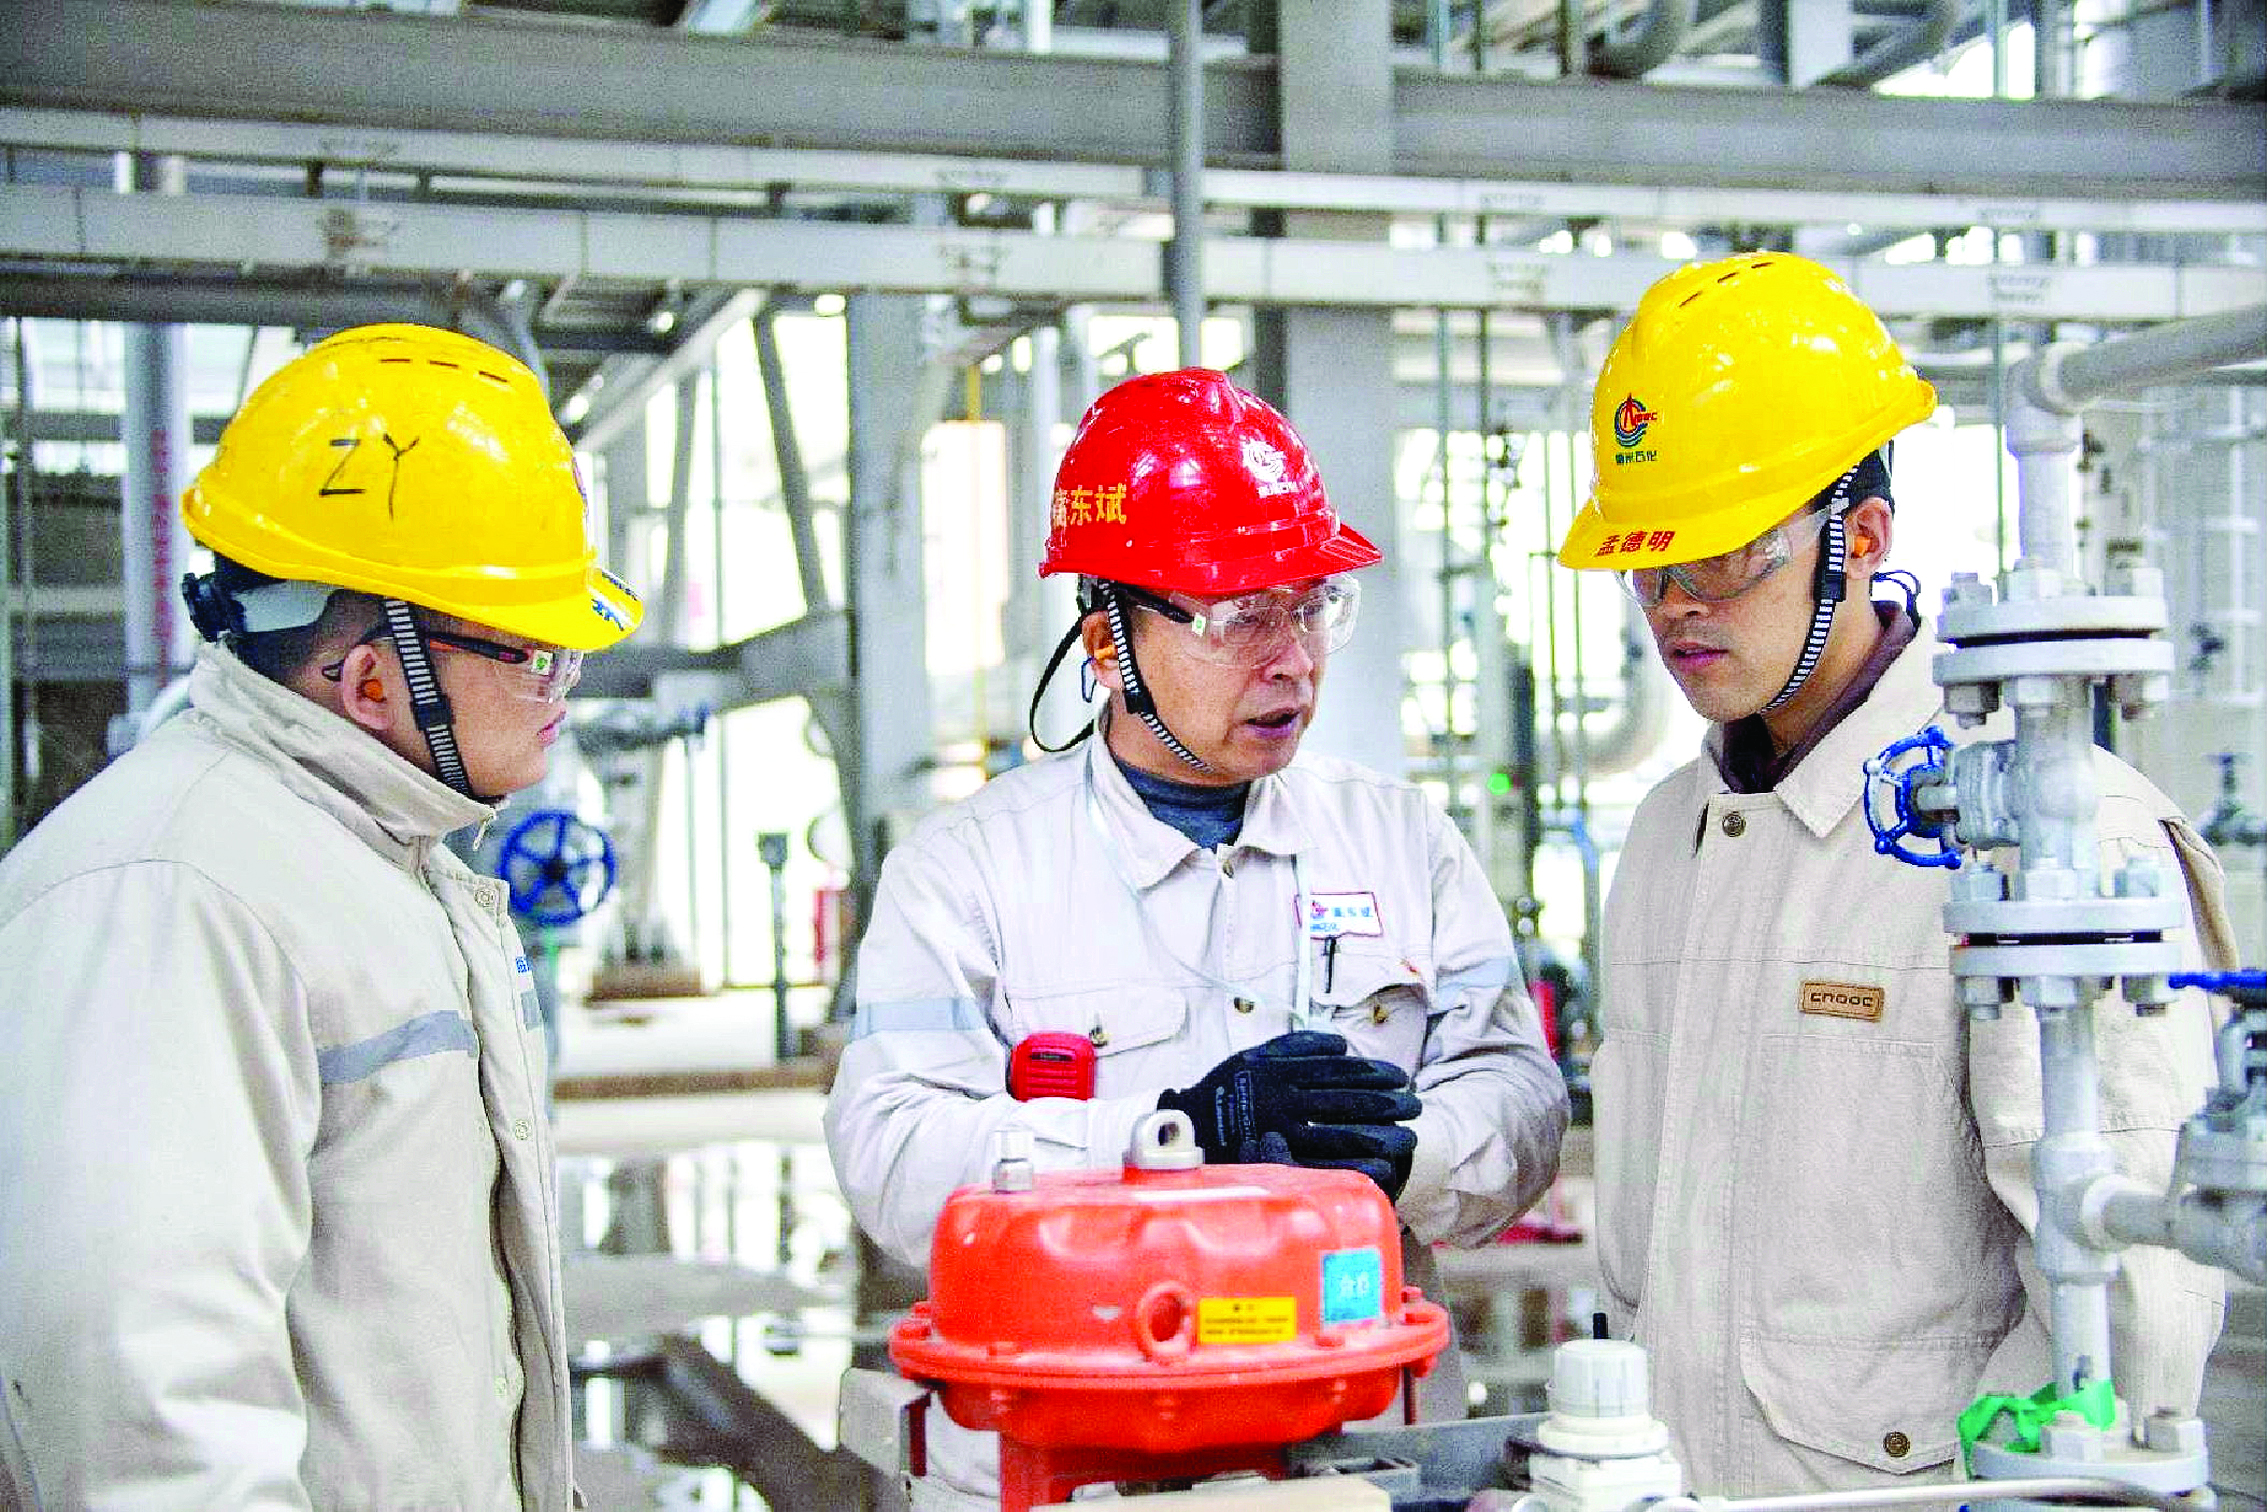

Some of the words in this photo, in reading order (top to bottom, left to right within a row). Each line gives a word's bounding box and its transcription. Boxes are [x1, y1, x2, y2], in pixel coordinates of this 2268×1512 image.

[319, 433, 420, 521] ZY
[1595, 531, 1675, 556] 孟德明
